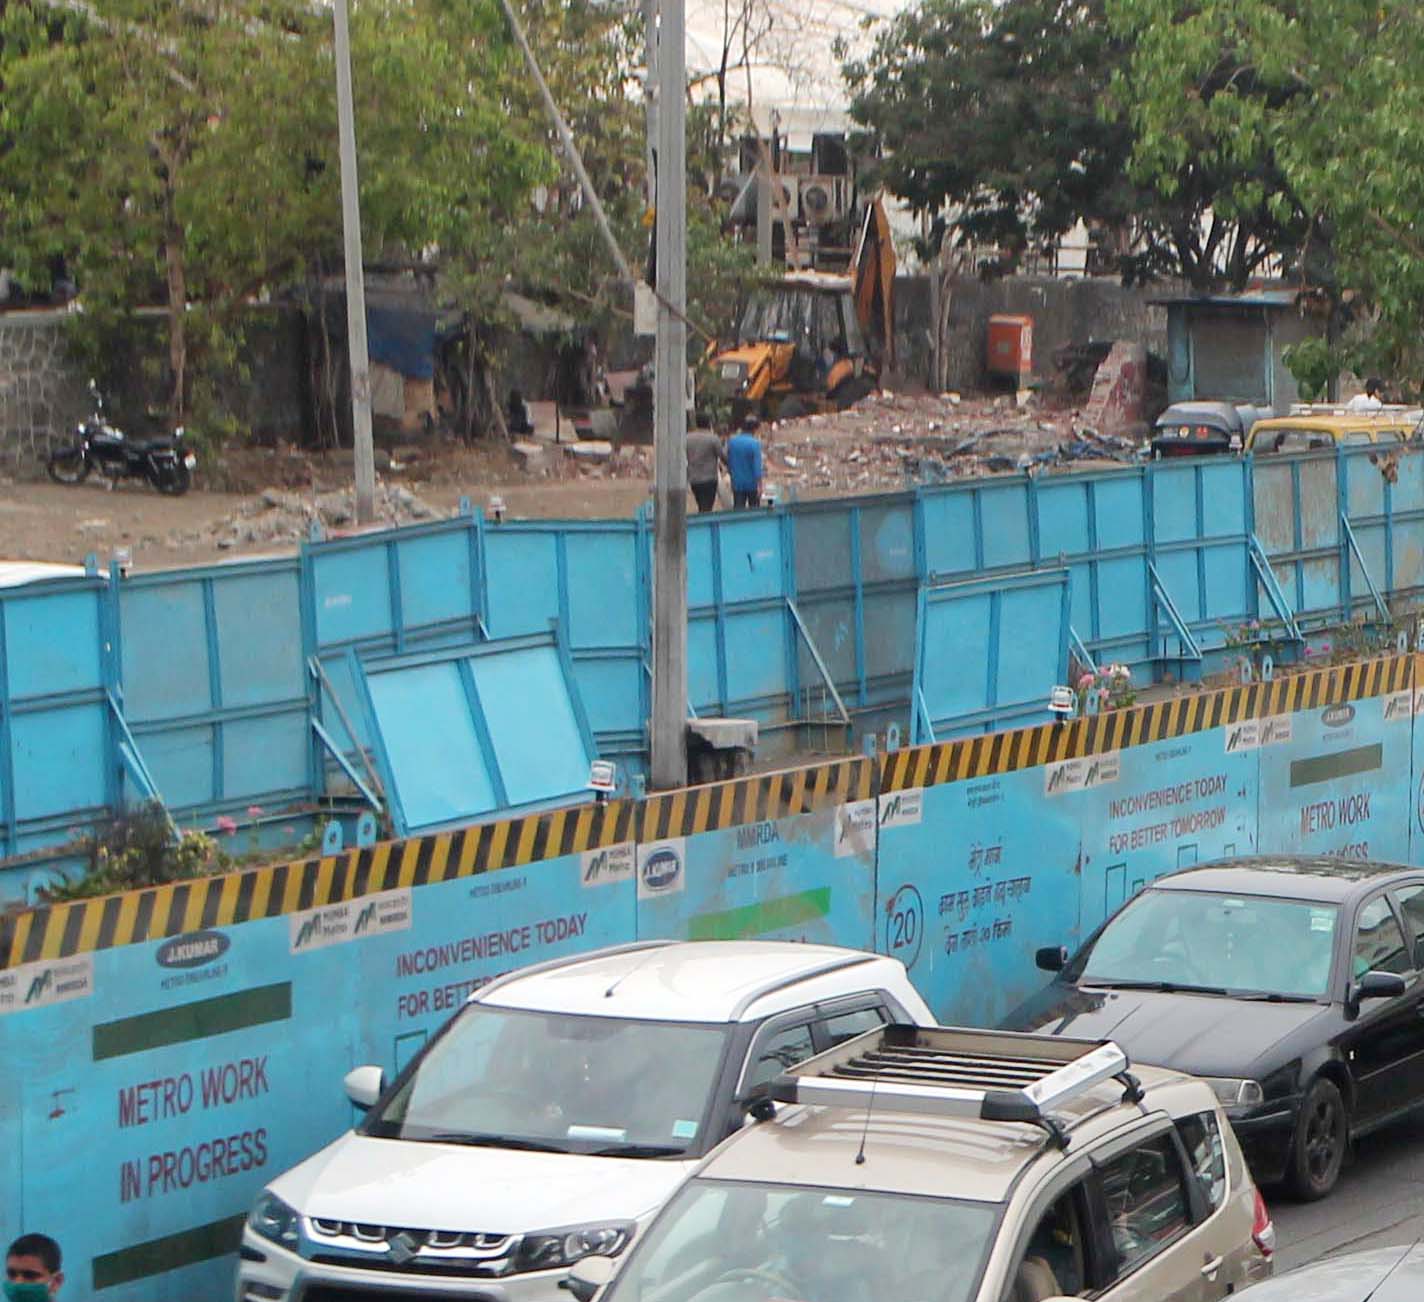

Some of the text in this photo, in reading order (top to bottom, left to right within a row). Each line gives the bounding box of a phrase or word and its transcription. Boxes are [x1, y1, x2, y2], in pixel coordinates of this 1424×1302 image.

[1109, 775, 1228, 820] INCONVENIENCE TODAY
[1300, 792, 1371, 835] METRO WORK
[1110, 807, 1226, 855] FOR BETTER TOMORROW
[397, 912, 588, 978] INCONVENIENCE TODAY
[893, 907, 916, 949] 20
[397, 992, 429, 1018] FOR
[118, 1055, 271, 1129] METRO WORK
[119, 1128, 269, 1204] IN PROGRESS
